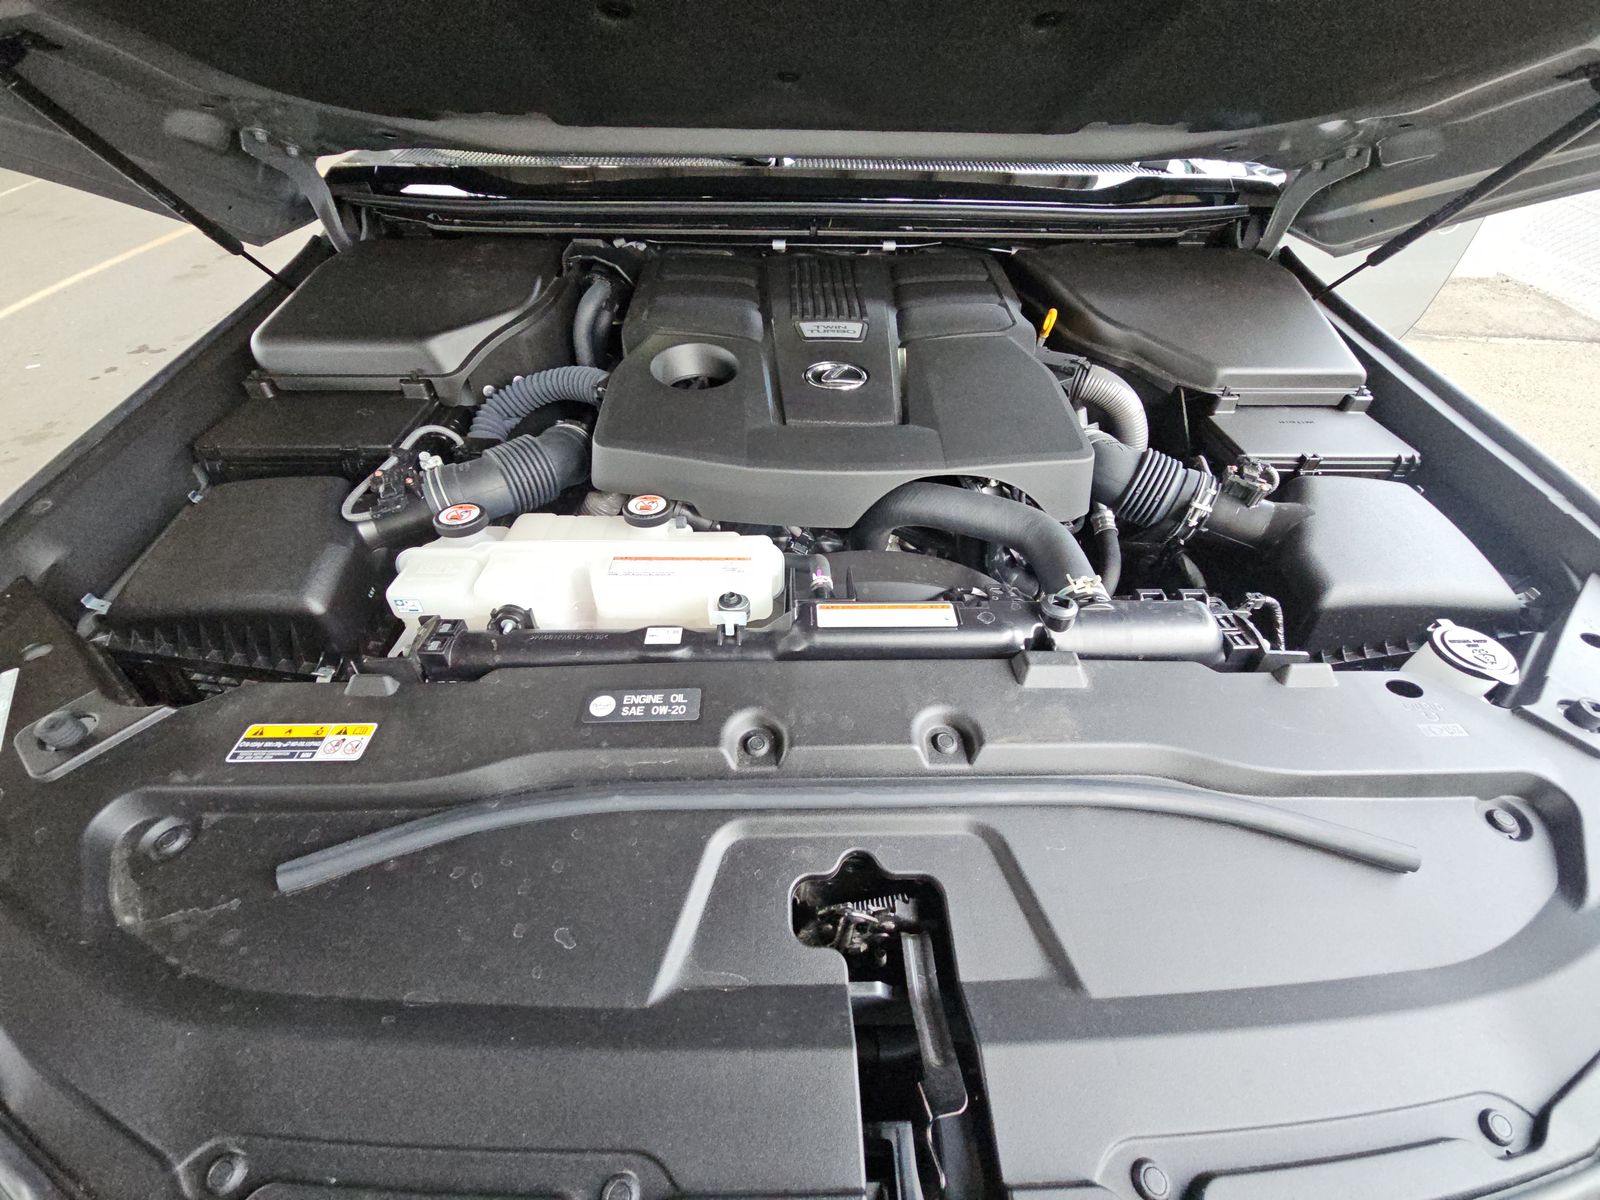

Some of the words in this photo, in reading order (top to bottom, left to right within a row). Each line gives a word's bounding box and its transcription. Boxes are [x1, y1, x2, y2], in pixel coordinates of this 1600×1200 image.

[623, 694, 664, 705] ENGINE
[670, 693, 688, 703] OIL
[621, 705, 645, 716] SAE
[651, 705, 687, 715] 0W-20
